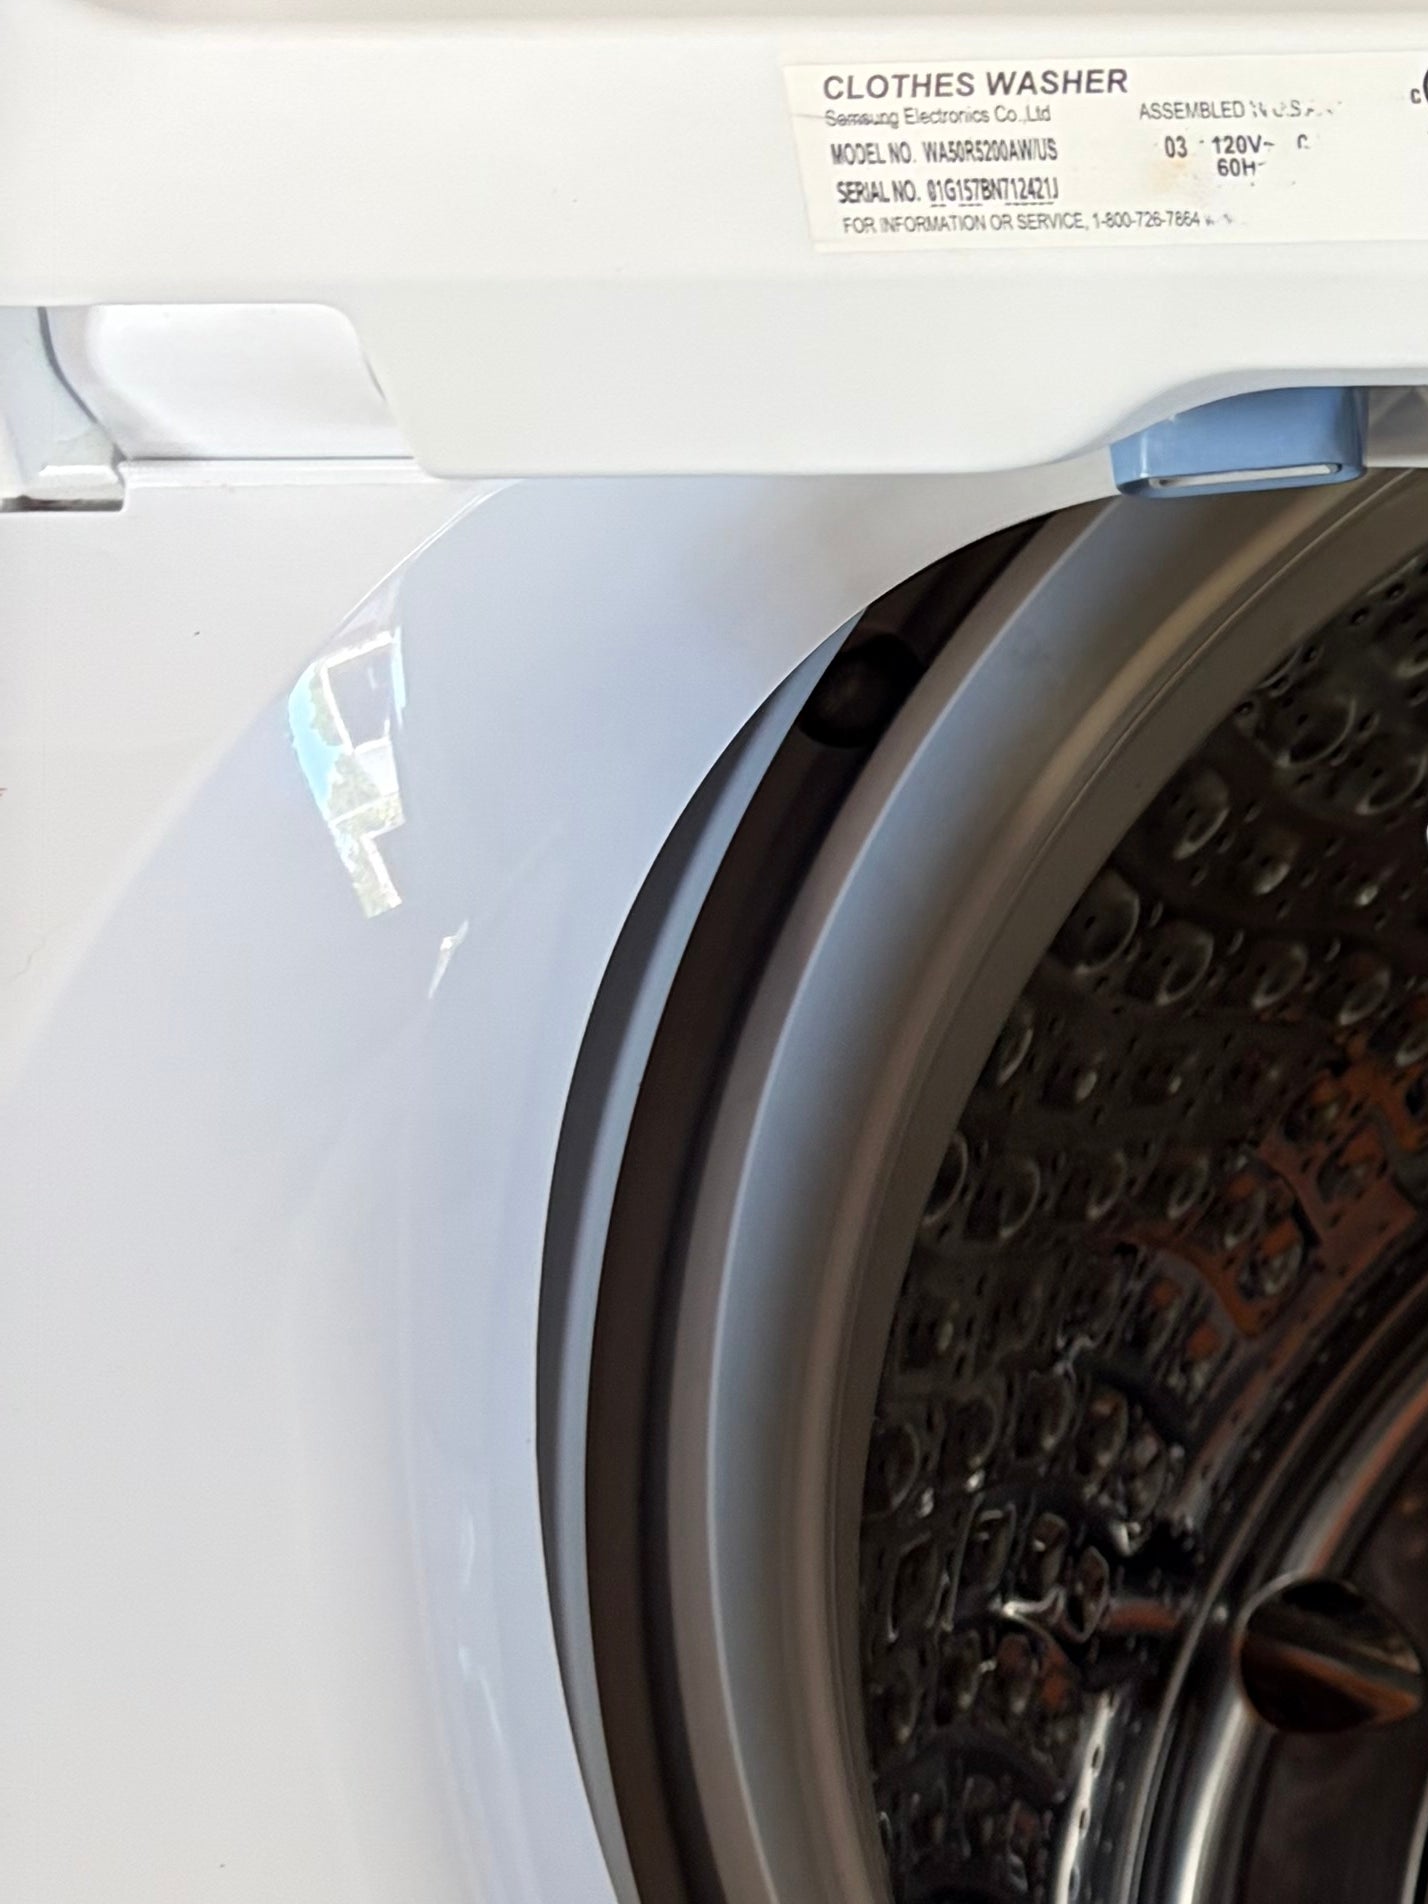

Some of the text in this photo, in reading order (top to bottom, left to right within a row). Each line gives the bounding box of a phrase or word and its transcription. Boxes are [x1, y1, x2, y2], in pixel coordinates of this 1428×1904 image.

[823, 69, 1128, 100] CLOTHES WASHER
[904, 106, 989, 124] Electronics
[1140, 101, 1245, 120] ASSEMBLED
[831, 143, 886, 165] MODEL
[888, 142, 916, 163] NO.
[1165, 136, 1187, 157] 03
[837, 180, 890, 203] SERIAL
[892, 180, 921, 202] NO.
[843, 216, 876, 233] FOR
[881, 215, 987, 231] INFORMATION
[990, 214, 1013, 229] OR
[1017, 213, 1089, 230] SERVICE,
